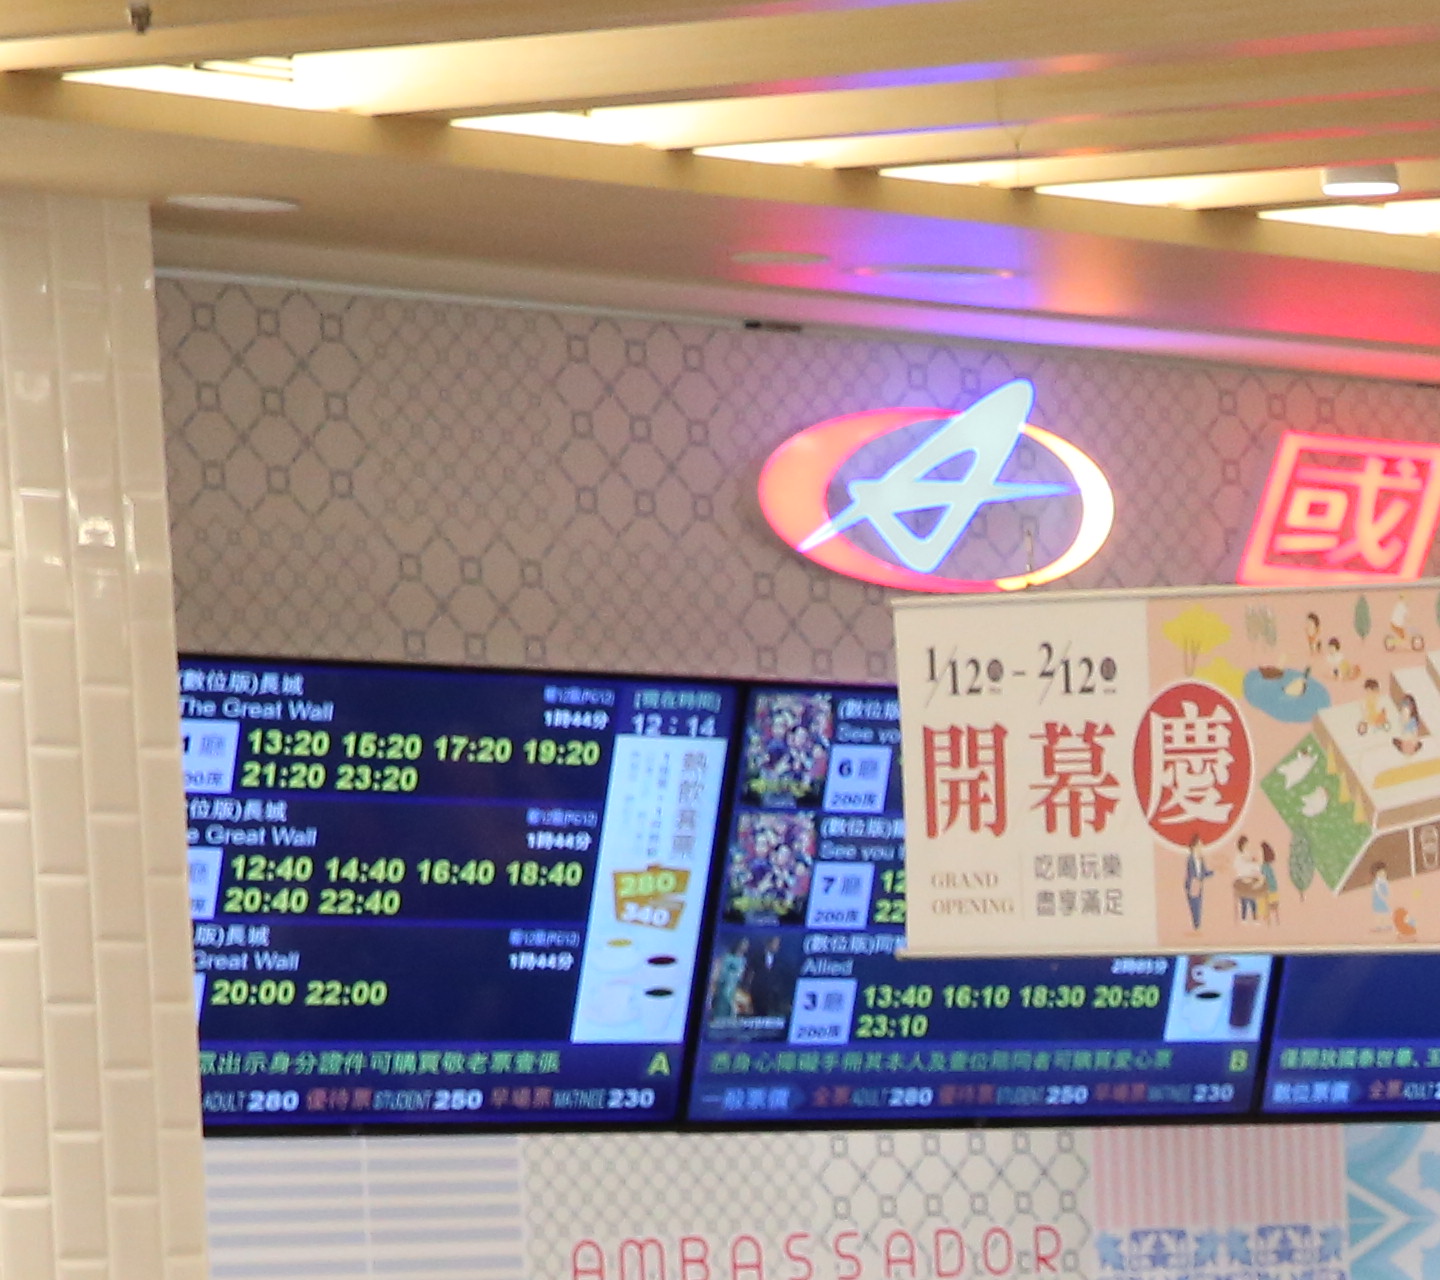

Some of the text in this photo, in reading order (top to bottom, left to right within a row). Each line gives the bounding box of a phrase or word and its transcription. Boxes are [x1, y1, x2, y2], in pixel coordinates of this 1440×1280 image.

[221, 697, 283, 719] Great
[288, 699, 335, 722] Wall
[246, 727, 601, 767] 13:20 15:20 17:20 19:20
[240, 760, 419, 793] 21:20 23:20
[922, 700, 1234, 839] 開幕慶
[204, 823, 318, 848] Great Wall
[231, 854, 584, 887] 12:40 14:40 16:40 18:40
[930, 870, 1000, 891] GRAND
[223, 886, 401, 916] 20:40 22:40
[931, 897, 1015, 915] OPENING
[253, 950, 300, 972] Wall
[803, 957, 854, 977] Allied
[210, 978, 388, 1007] 20:00 22:00
[863, 984, 1161, 1009] 13:40 16:10 18:30 20:50
[855, 1013, 930, 1039] 23:10
[647, 1051, 672, 1077] A
